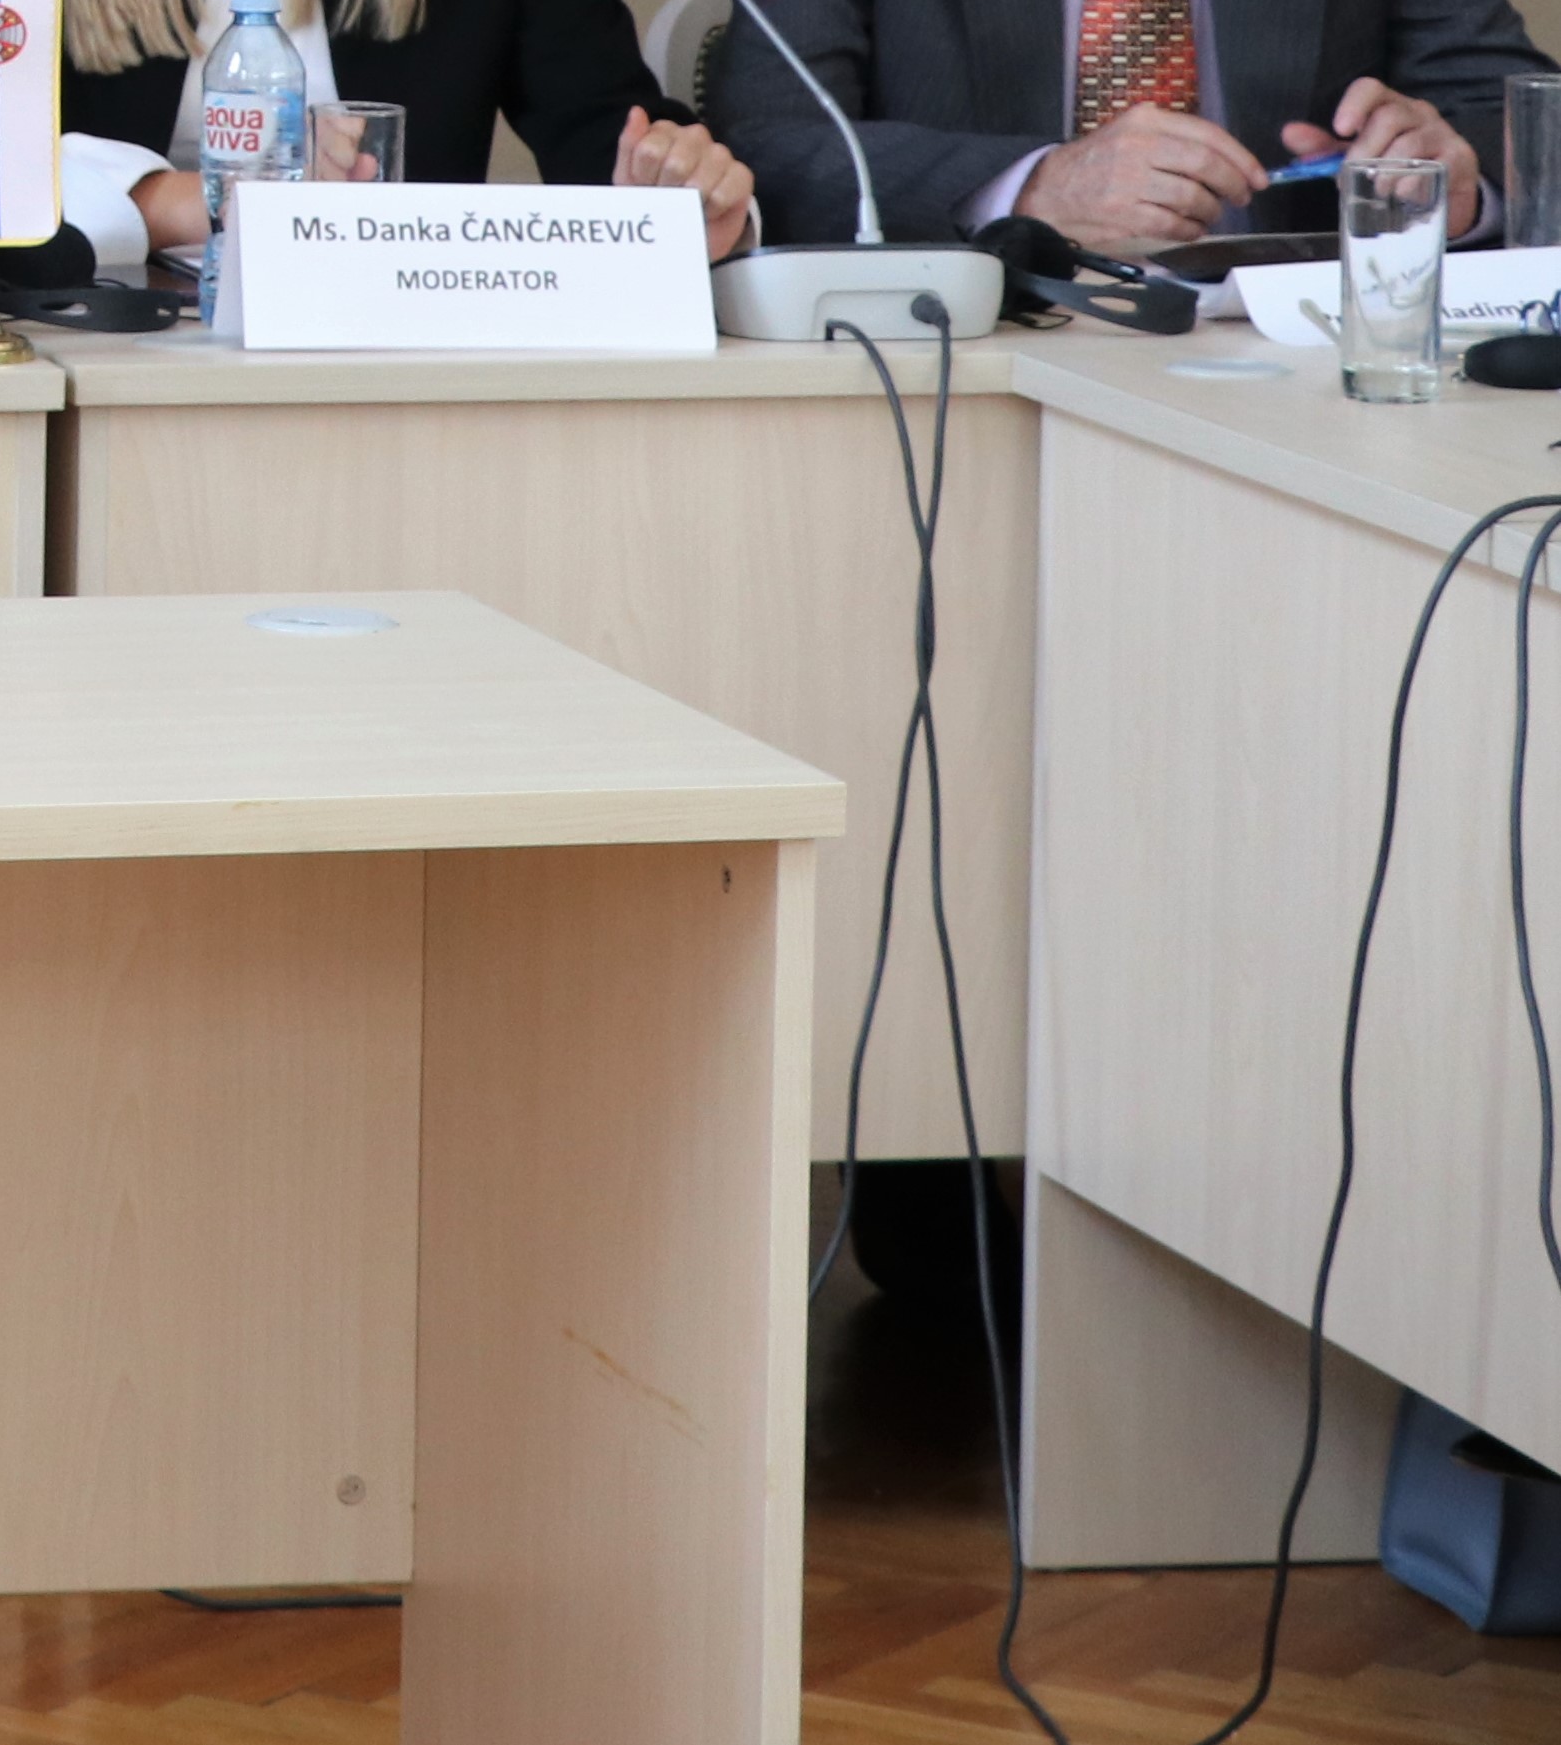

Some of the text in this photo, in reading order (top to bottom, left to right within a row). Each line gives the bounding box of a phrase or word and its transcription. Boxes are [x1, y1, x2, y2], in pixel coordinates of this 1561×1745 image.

[207, 130, 259, 151] viva
[291, 211, 656, 244] Ms. Danka ČANČAREVIĆ
[396, 269, 559, 291] MODERATOR
